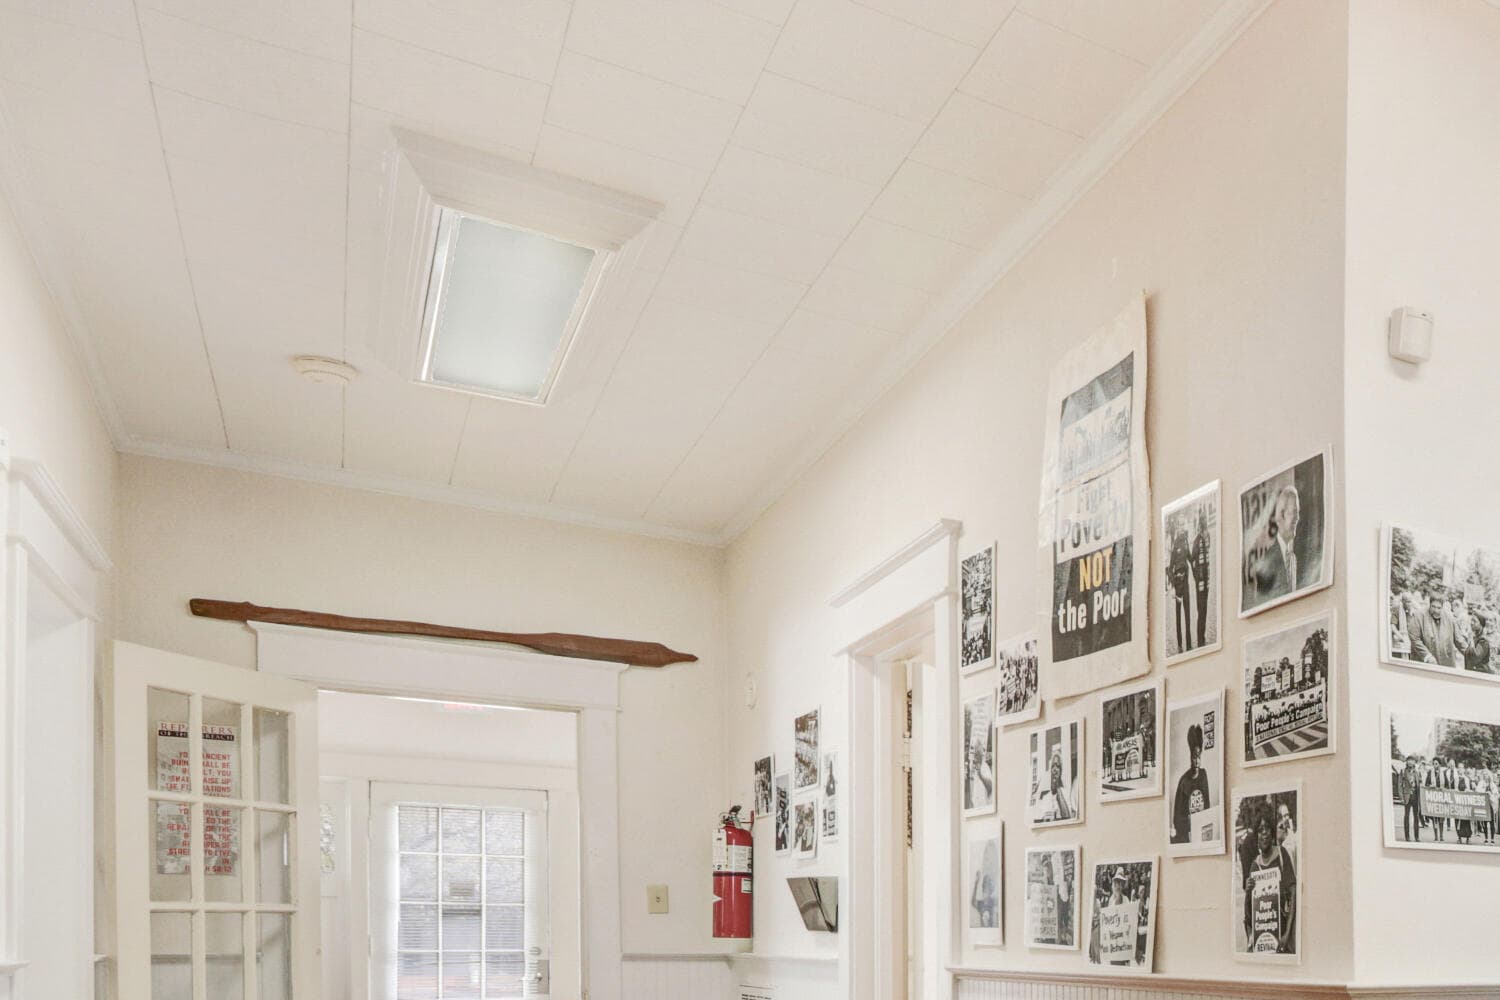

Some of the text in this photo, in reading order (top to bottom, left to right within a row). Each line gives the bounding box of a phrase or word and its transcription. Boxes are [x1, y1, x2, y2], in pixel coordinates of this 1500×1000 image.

[1079, 547, 1113, 593] NOT
[1058, 586, 1128, 634] the Poor
